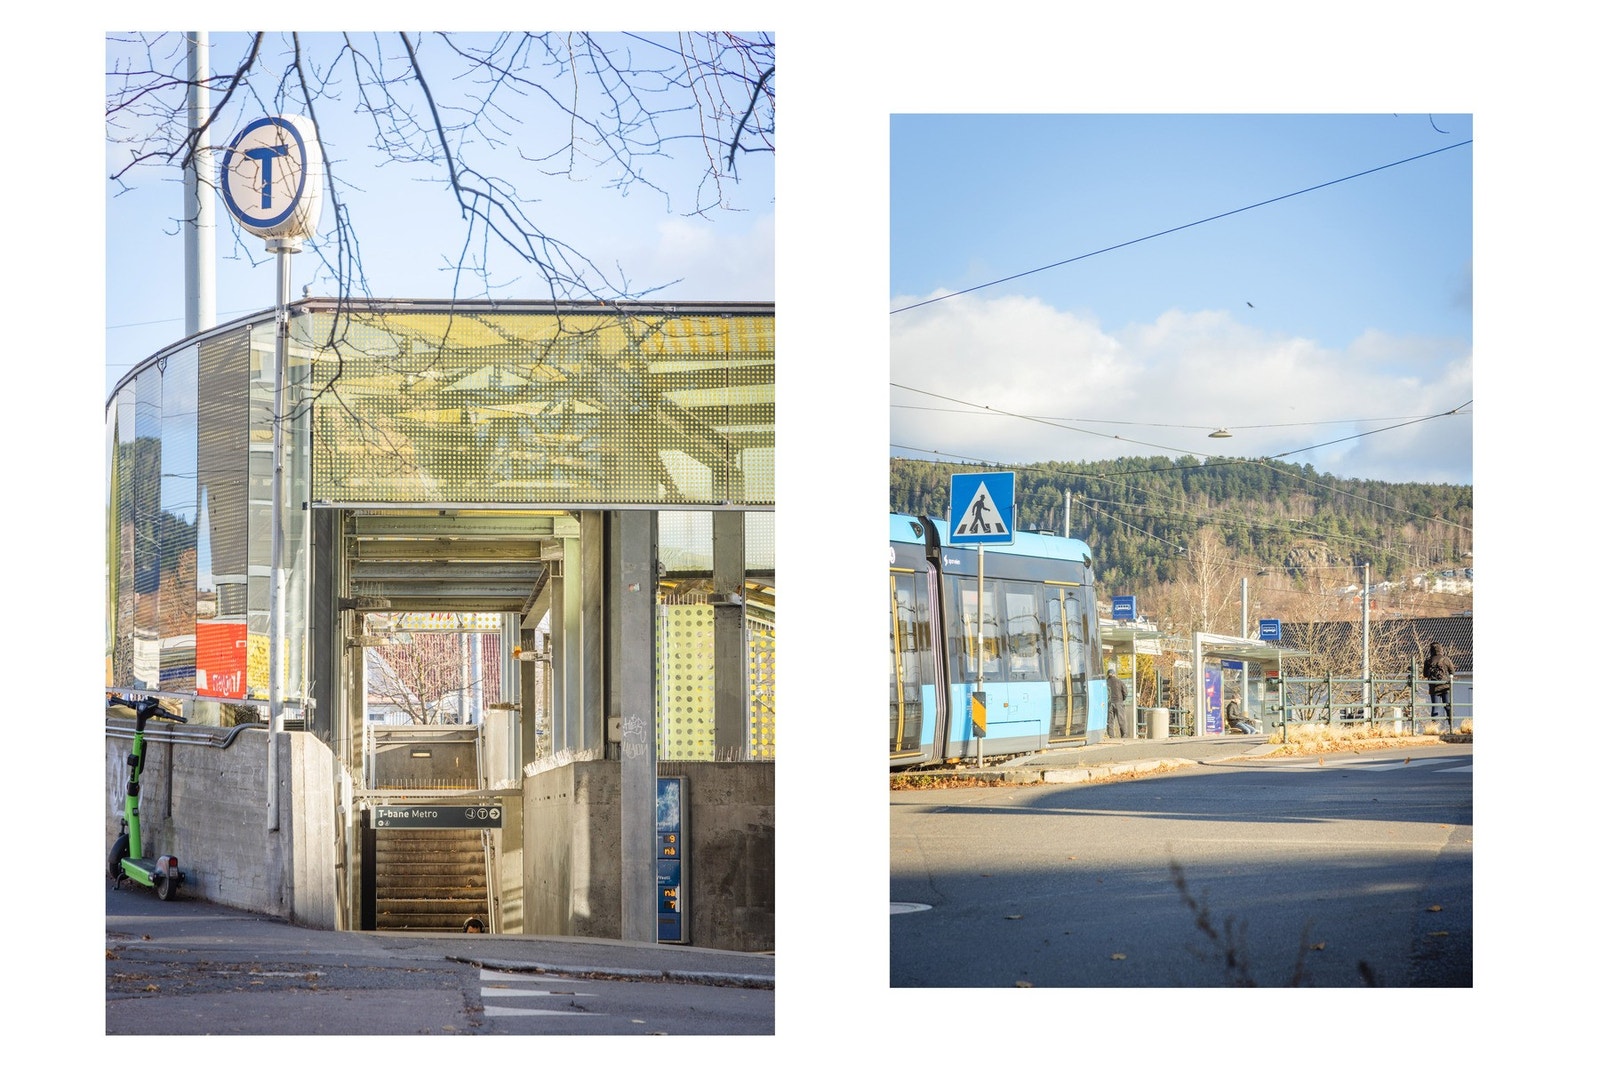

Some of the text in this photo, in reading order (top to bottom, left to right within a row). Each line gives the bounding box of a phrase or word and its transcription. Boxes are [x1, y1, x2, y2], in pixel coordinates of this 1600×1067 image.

[244, 144, 289, 210] T
[378, 809, 438, 818] T-bane Metro
[669, 835, 676, 843] 9
